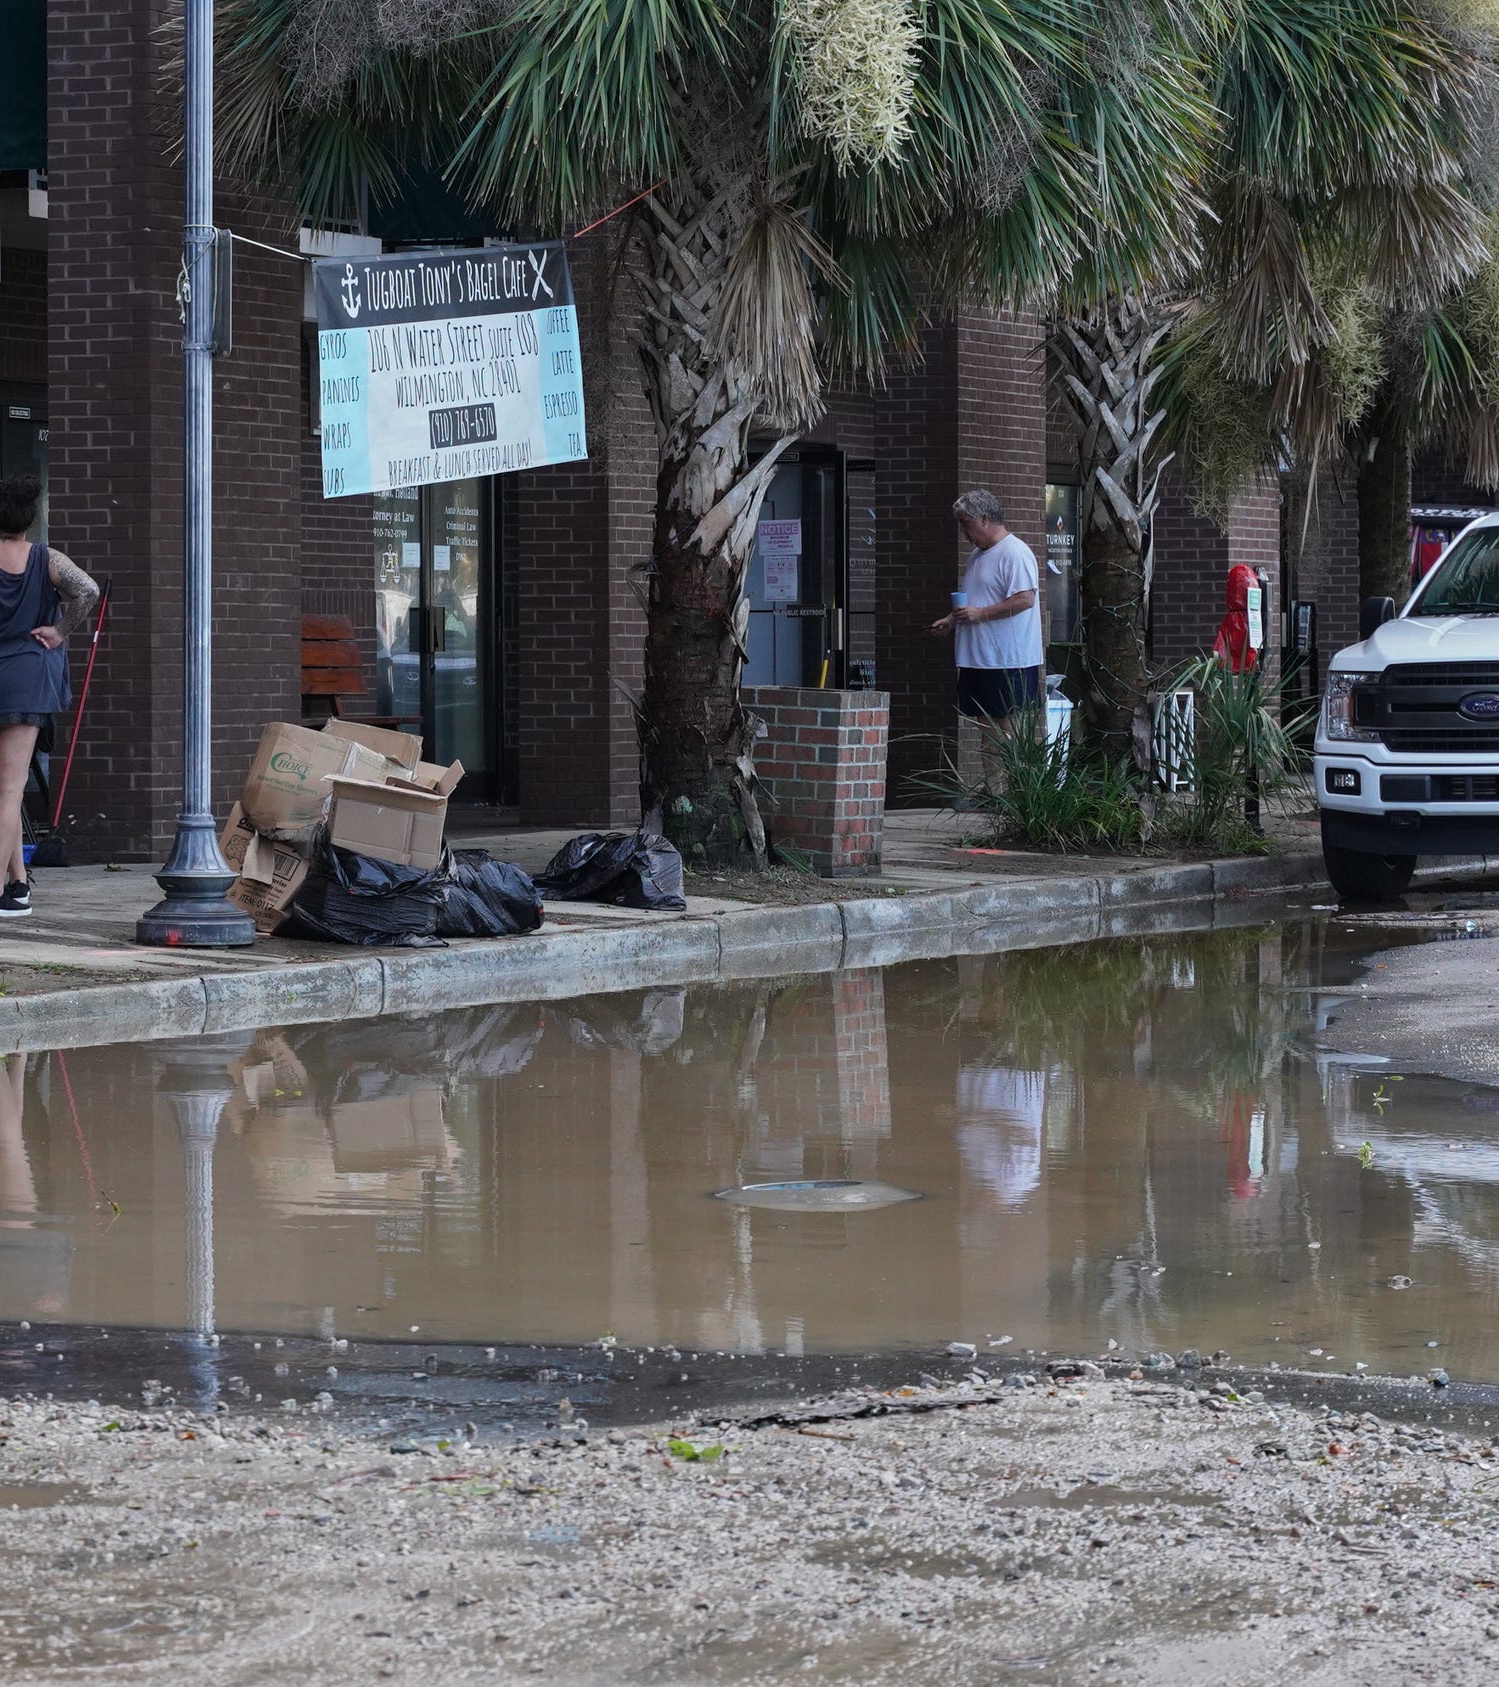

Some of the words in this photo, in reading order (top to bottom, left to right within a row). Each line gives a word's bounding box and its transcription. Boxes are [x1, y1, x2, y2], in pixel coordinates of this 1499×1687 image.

[364, 265, 416, 311] TUGBOAT
[418, 259, 464, 306] TONY'S
[465, 259, 501, 302] BAGEL
[502, 255, 529, 299] CAFE
[320, 332, 347, 360] GYROS
[367, 328, 390, 373] 106
[392, 326, 404, 370] N
[405, 324, 443, 368] WATER
[446, 320, 486, 365] STREET
[514, 312, 539, 357] 108
[552, 350, 575, 376] LATTE
[322, 376, 360, 406] PANINIS
[395, 368, 470, 408] WILMINGTON,
[471, 366, 489, 399] NC
[488, 359, 521, 398] 28401
[544, 391, 578, 419] ESPRESSO
[323, 422, 352, 451] WRAPS
[430, 412, 453, 448] (910)
[568, 432, 582, 457] TEA
[388, 456, 431, 486] BREAKFAST
[433, 452, 442, 480] &
[443, 449, 471, 478] LUNCH
[473, 443, 501, 474] SERVED
[502, 440, 516, 469] ALL
[323, 467, 344, 495] SUBS
[402, 511, 415, 523] Law
[760, 524, 799, 535] NOTICE
[1046, 534, 1075, 545] TURNKEY
